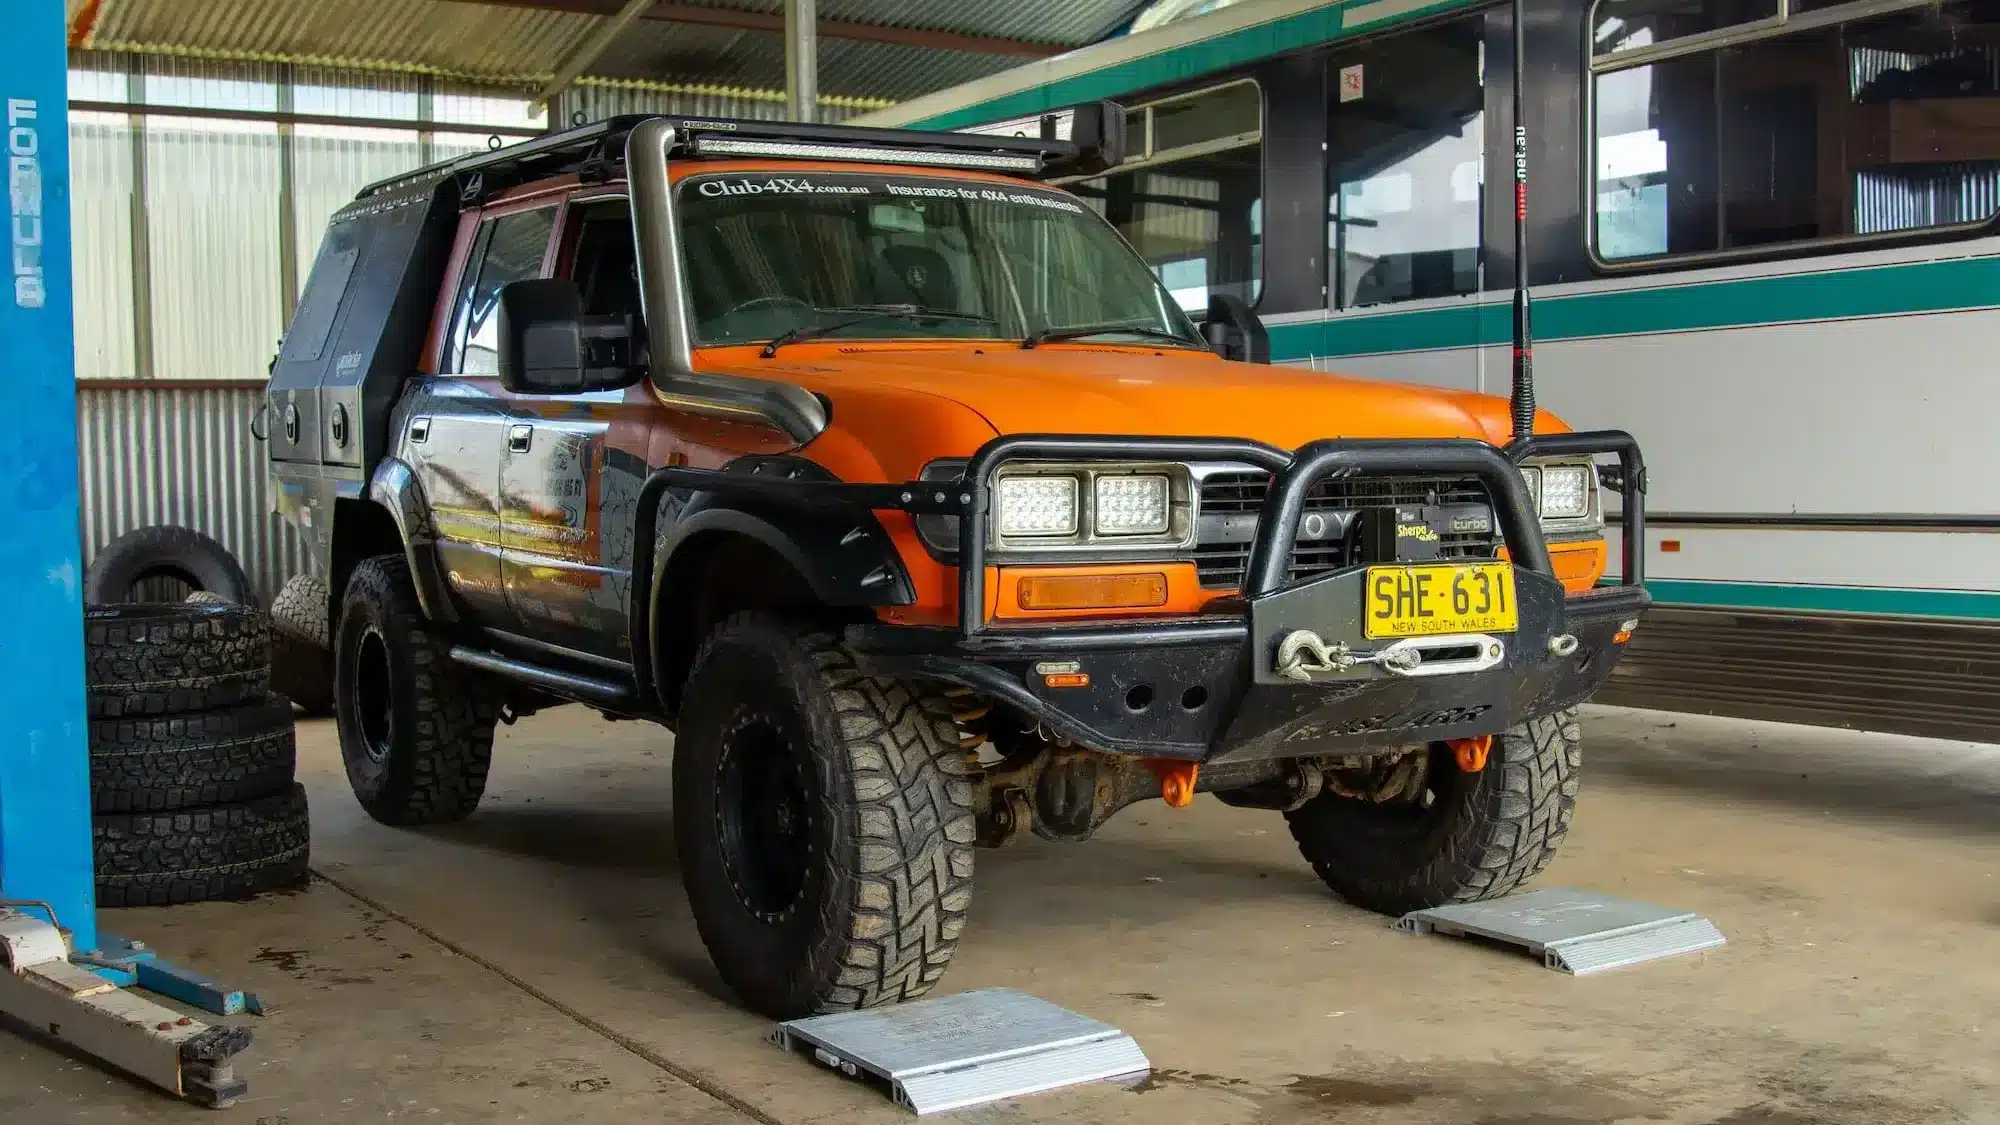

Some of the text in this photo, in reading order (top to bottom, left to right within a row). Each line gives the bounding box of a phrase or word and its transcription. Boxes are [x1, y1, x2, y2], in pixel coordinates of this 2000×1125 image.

[699, 178, 870, 197] Club4X4.com.au
[886, 184, 1084, 214] Insurance for 4X4 enthusiasts
[1397, 524, 1427, 539] Sherpa
[1453, 518, 1488, 531] turbo
[1392, 618, 1496, 633] NEW SOUTH WALES
